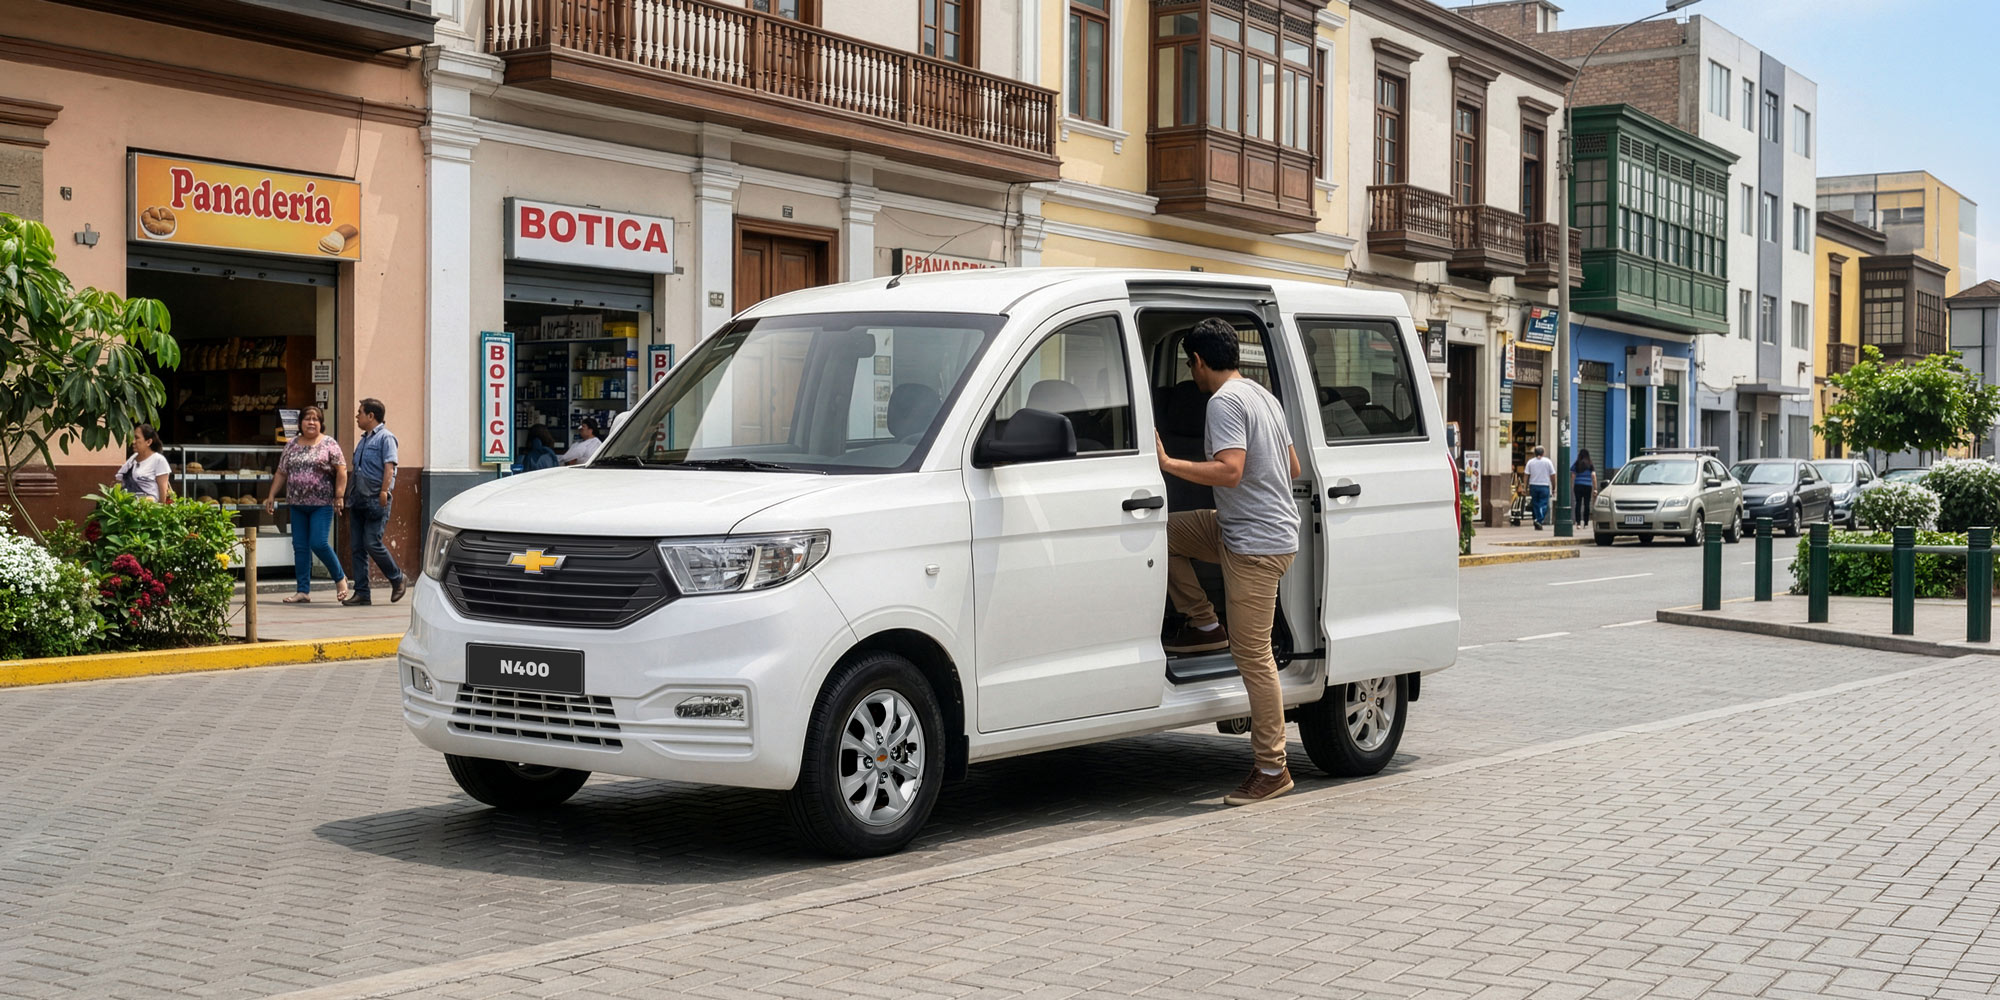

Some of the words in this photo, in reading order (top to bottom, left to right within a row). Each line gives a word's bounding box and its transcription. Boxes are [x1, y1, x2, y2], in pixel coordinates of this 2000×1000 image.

[520, 206, 668, 254] BOTICA
[489, 345, 505, 454] BOTICA
[500, 659, 550, 677] N400
